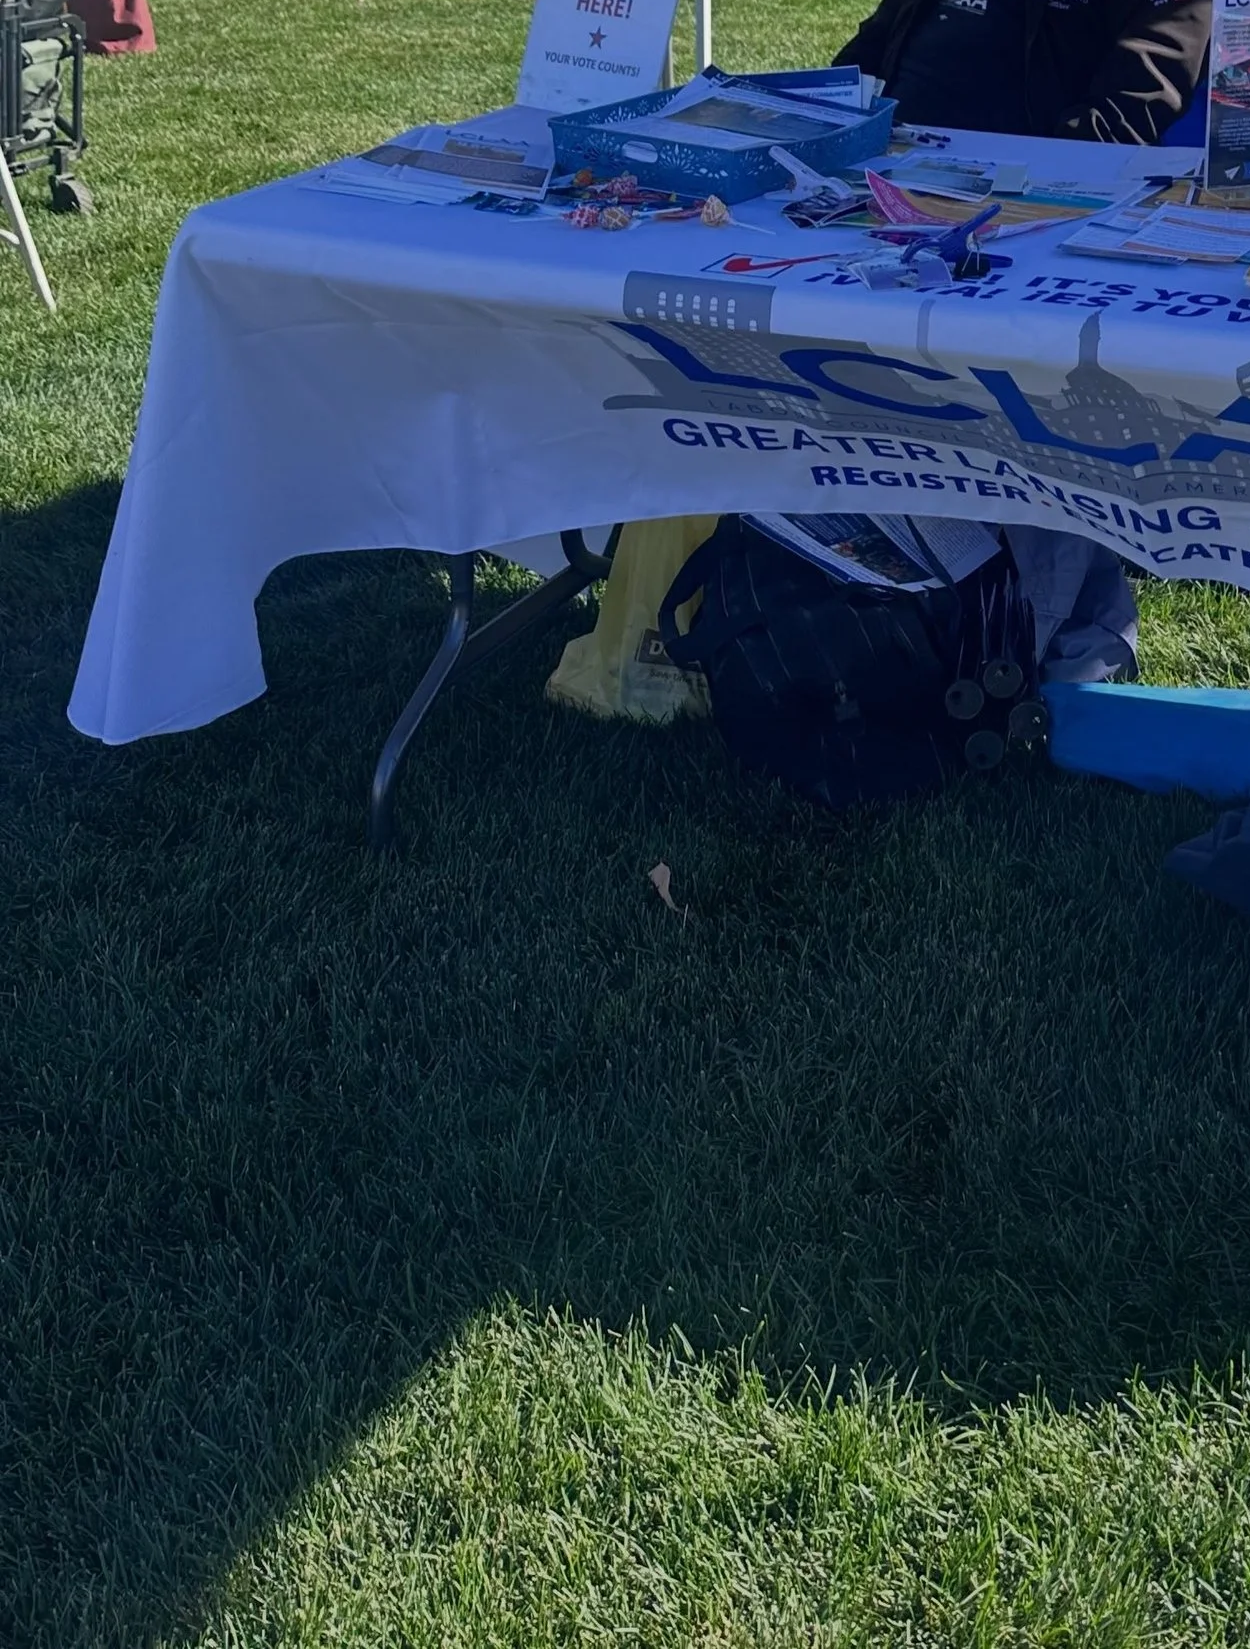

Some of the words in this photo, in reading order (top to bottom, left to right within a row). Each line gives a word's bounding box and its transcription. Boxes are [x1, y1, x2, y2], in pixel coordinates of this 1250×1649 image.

[544, 50, 571, 66] YOUR
[571, 56, 597, 71] VOTE
[598, 61, 641, 78] COUNTS!
[1026, 276, 1137, 296] IT'S
[1132, 300, 1213, 317] TU
[662, 417, 945, 464] GREATER
[953, 449, 1222, 535] LANSING
[828, 418, 960, 442] COUNCIL
[1058, 467, 1141, 500] LATIN
[810, 465, 1031, 505] REGISTER
